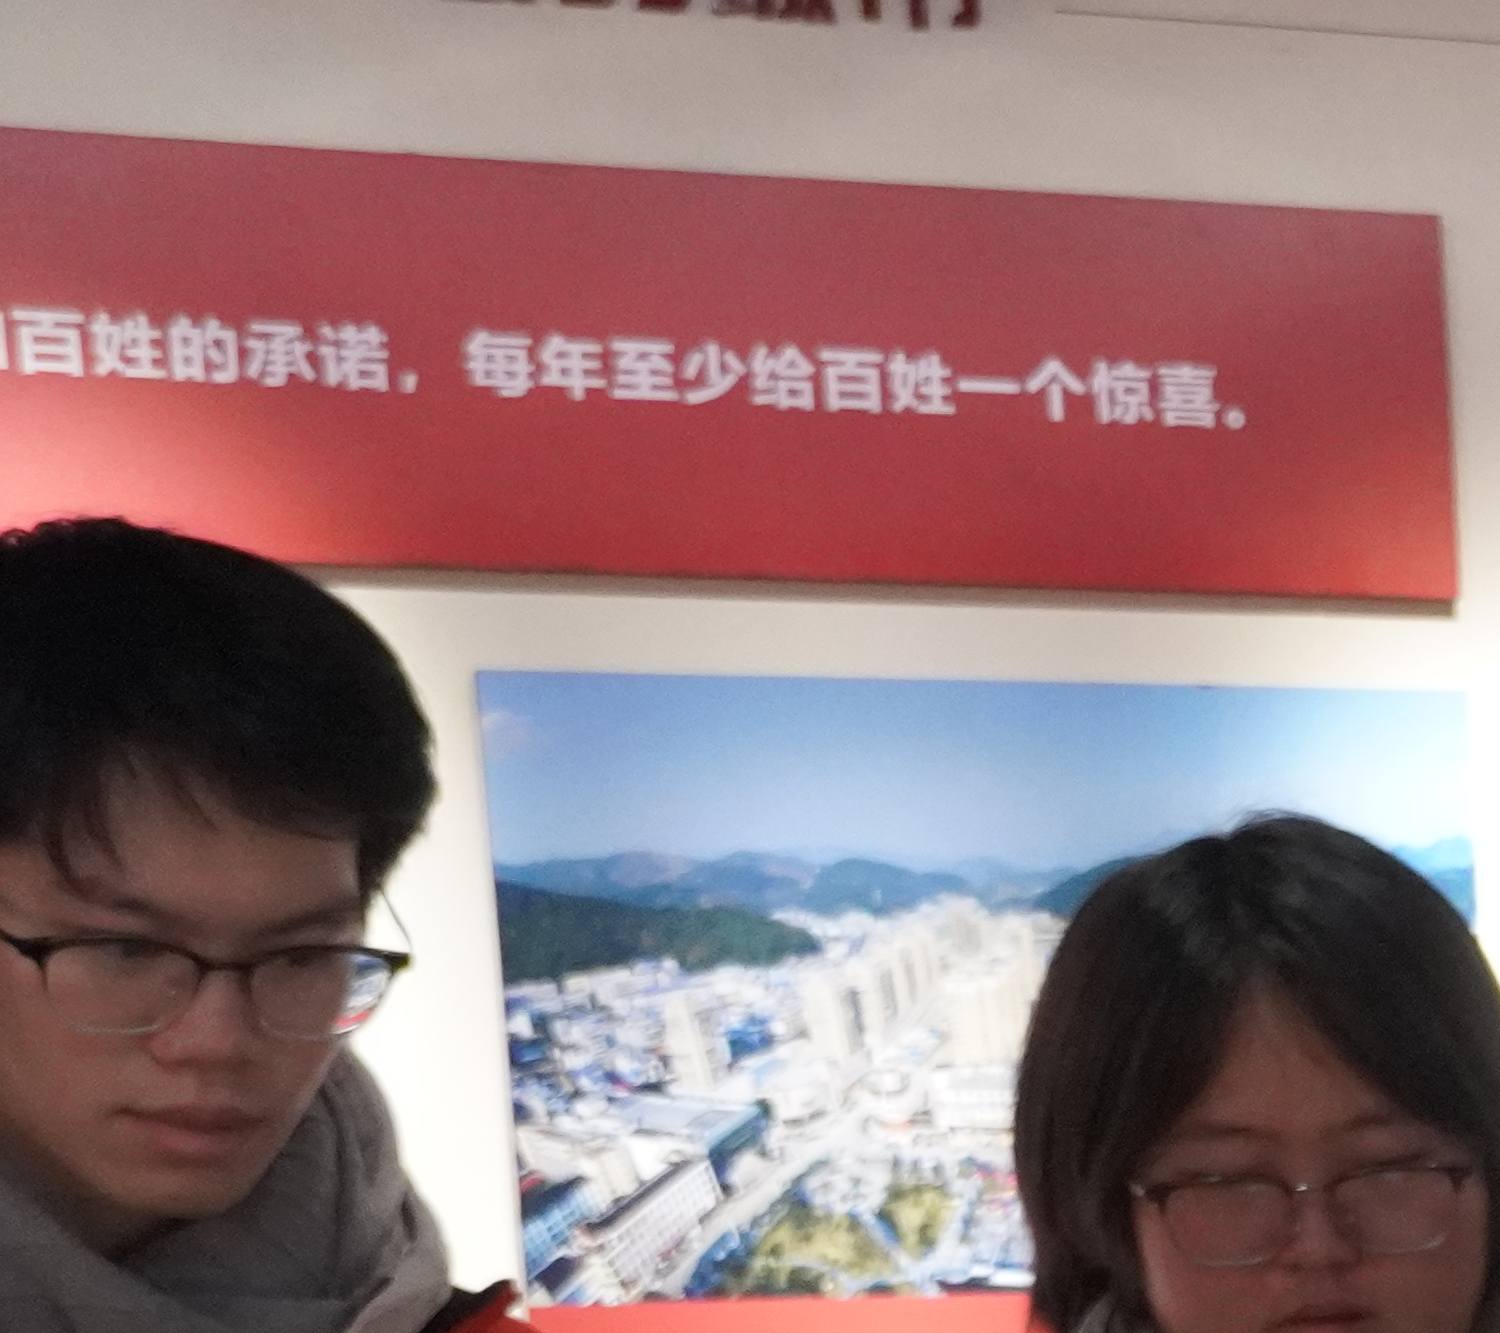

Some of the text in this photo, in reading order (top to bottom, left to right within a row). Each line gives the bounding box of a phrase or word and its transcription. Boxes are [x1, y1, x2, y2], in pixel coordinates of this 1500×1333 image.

[0, 306, 1247, 430] 百姓的承诺，每年至少给百姓一个惊喜。
